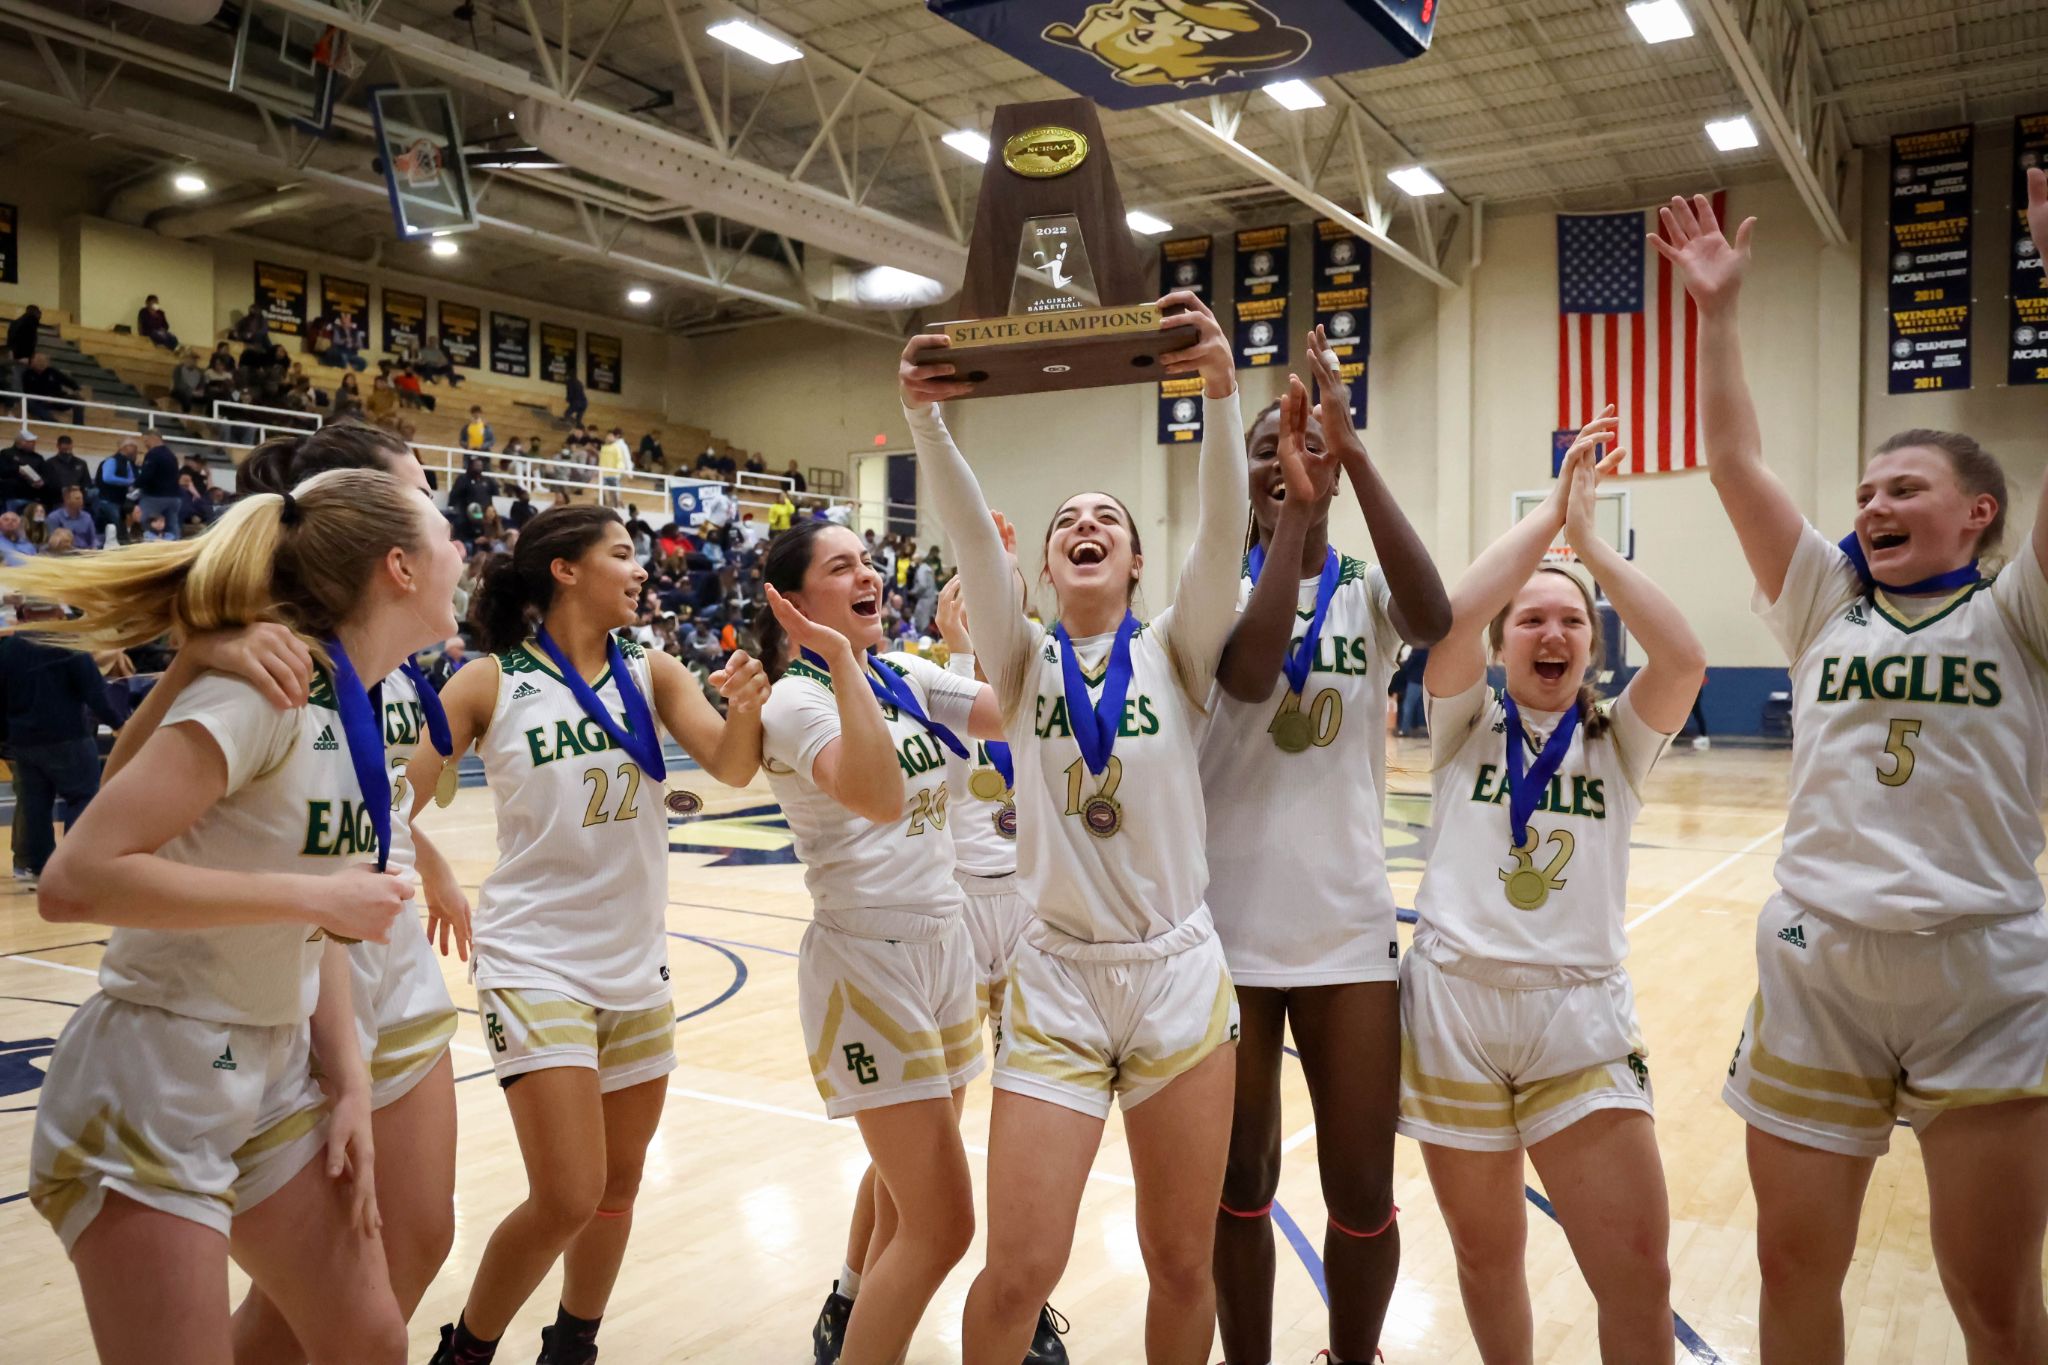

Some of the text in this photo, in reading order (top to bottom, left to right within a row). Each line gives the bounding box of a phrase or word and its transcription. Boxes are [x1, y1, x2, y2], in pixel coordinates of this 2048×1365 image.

[1036, 226, 1067, 236] 2022
[1894, 216, 1968, 234] WINGATE
[1897, 227, 1965, 241] UNIVERSITY
[1892, 272, 1925, 284] NCAA
[1027, 301, 1083, 312] BASKETBALL
[1893, 305, 1967, 322] WINGATE
[955, 310, 1152, 343] STATE CHAMPIONS
[1896, 316, 1965, 328] UNIVERSITY
[1900, 324, 1960, 336] VOLLEYBALL
[1915, 338, 1967, 352] CHAMPION
[2012, 348, 2048, 360] NCAA
[1892, 359, 1925, 371] NCAA
[1913, 376, 1943, 390] 2011
[1816, 654, 2003, 707] EAGLES
[512, 687, 542, 700] adidas
[1035, 694, 1160, 739] EAES
[313, 741, 339, 750] adidas
[525, 711, 637, 768] EAG
[1876, 718, 1922, 787] 5
[582, 762, 641, 828] 22
[300, 800, 377, 856] EAG
[1498, 825, 1575, 891] 32
[1777, 930, 1807, 949] adidas
